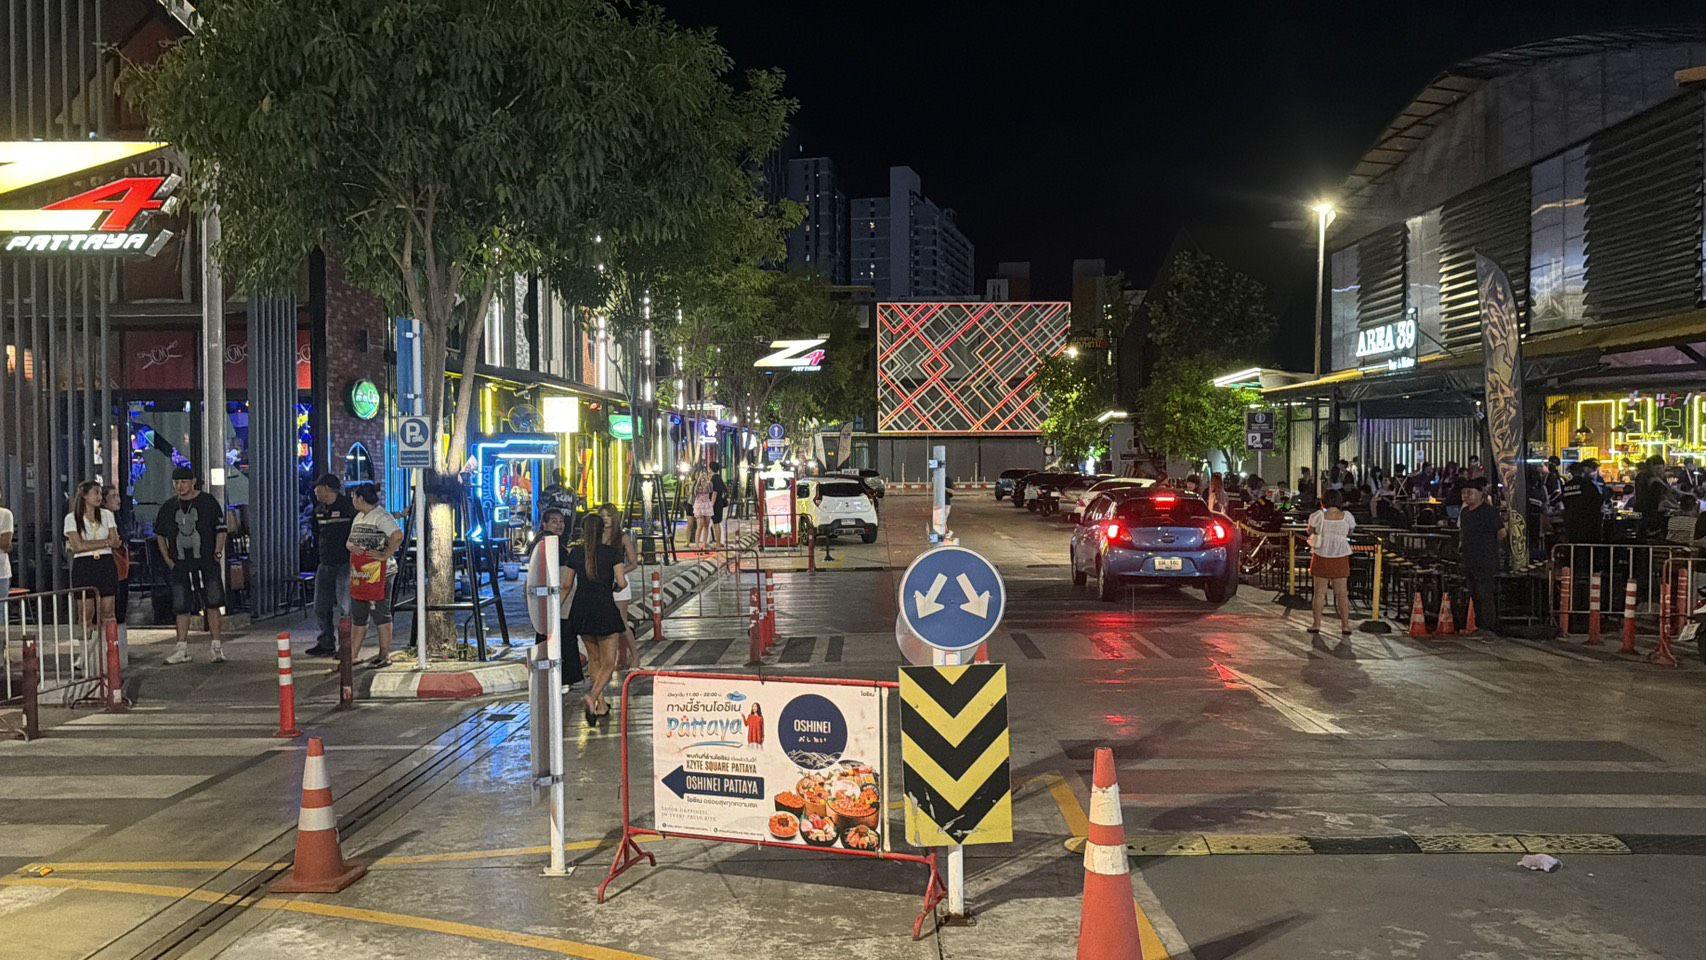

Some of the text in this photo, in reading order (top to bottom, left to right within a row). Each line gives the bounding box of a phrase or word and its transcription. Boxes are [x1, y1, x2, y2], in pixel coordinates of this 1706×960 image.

[6, 233, 149, 251] PATTAYA
[1355, 319, 1416, 357] AREA 39
[405, 422, 421, 444] P
[667, 698, 741, 712] ทางนี้ร้านโอชิเน
[666, 715, 742, 742] Pattaya
[793, 719, 832, 733] OSHINEI
[686, 760, 757, 774] XZYTE SQUARE PATTAYA
[686, 775, 758, 795] OSHINEI PATTAYA
